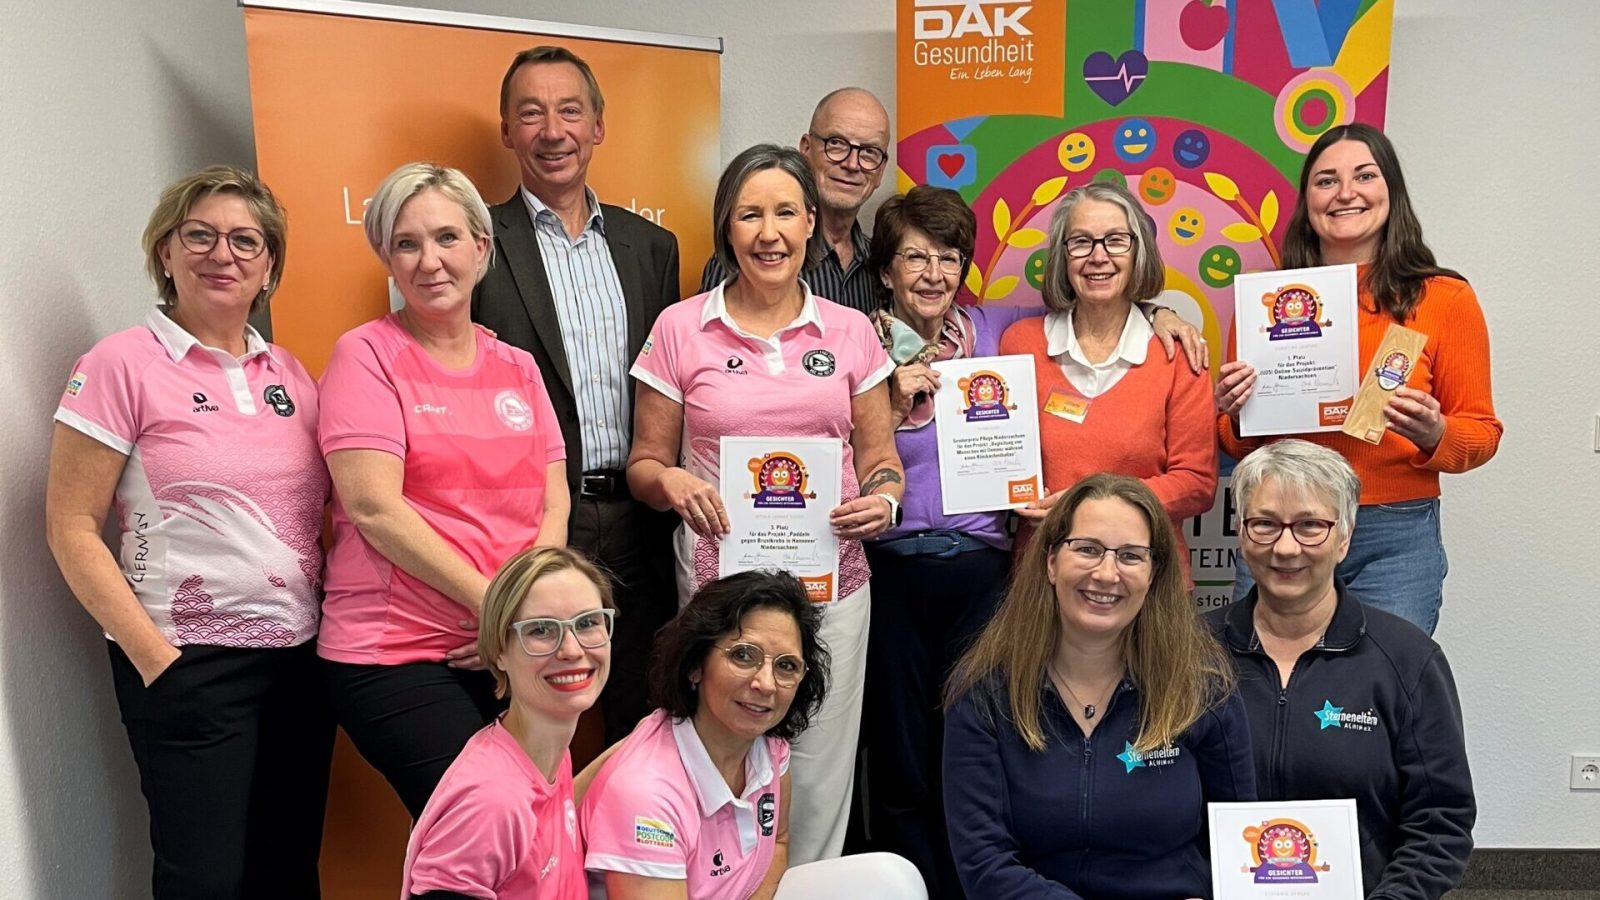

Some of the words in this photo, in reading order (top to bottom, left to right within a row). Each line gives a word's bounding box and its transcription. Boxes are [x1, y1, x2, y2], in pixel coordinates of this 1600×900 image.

[915, 3, 1034, 40] DAK
[914, 38, 1034, 66] Gesundheit
[950, 68, 969, 80] Ein
[974, 66, 1005, 80] Leben
[193, 403, 219, 413] artiva
[1324, 709, 1378, 726] Sterneneltern
